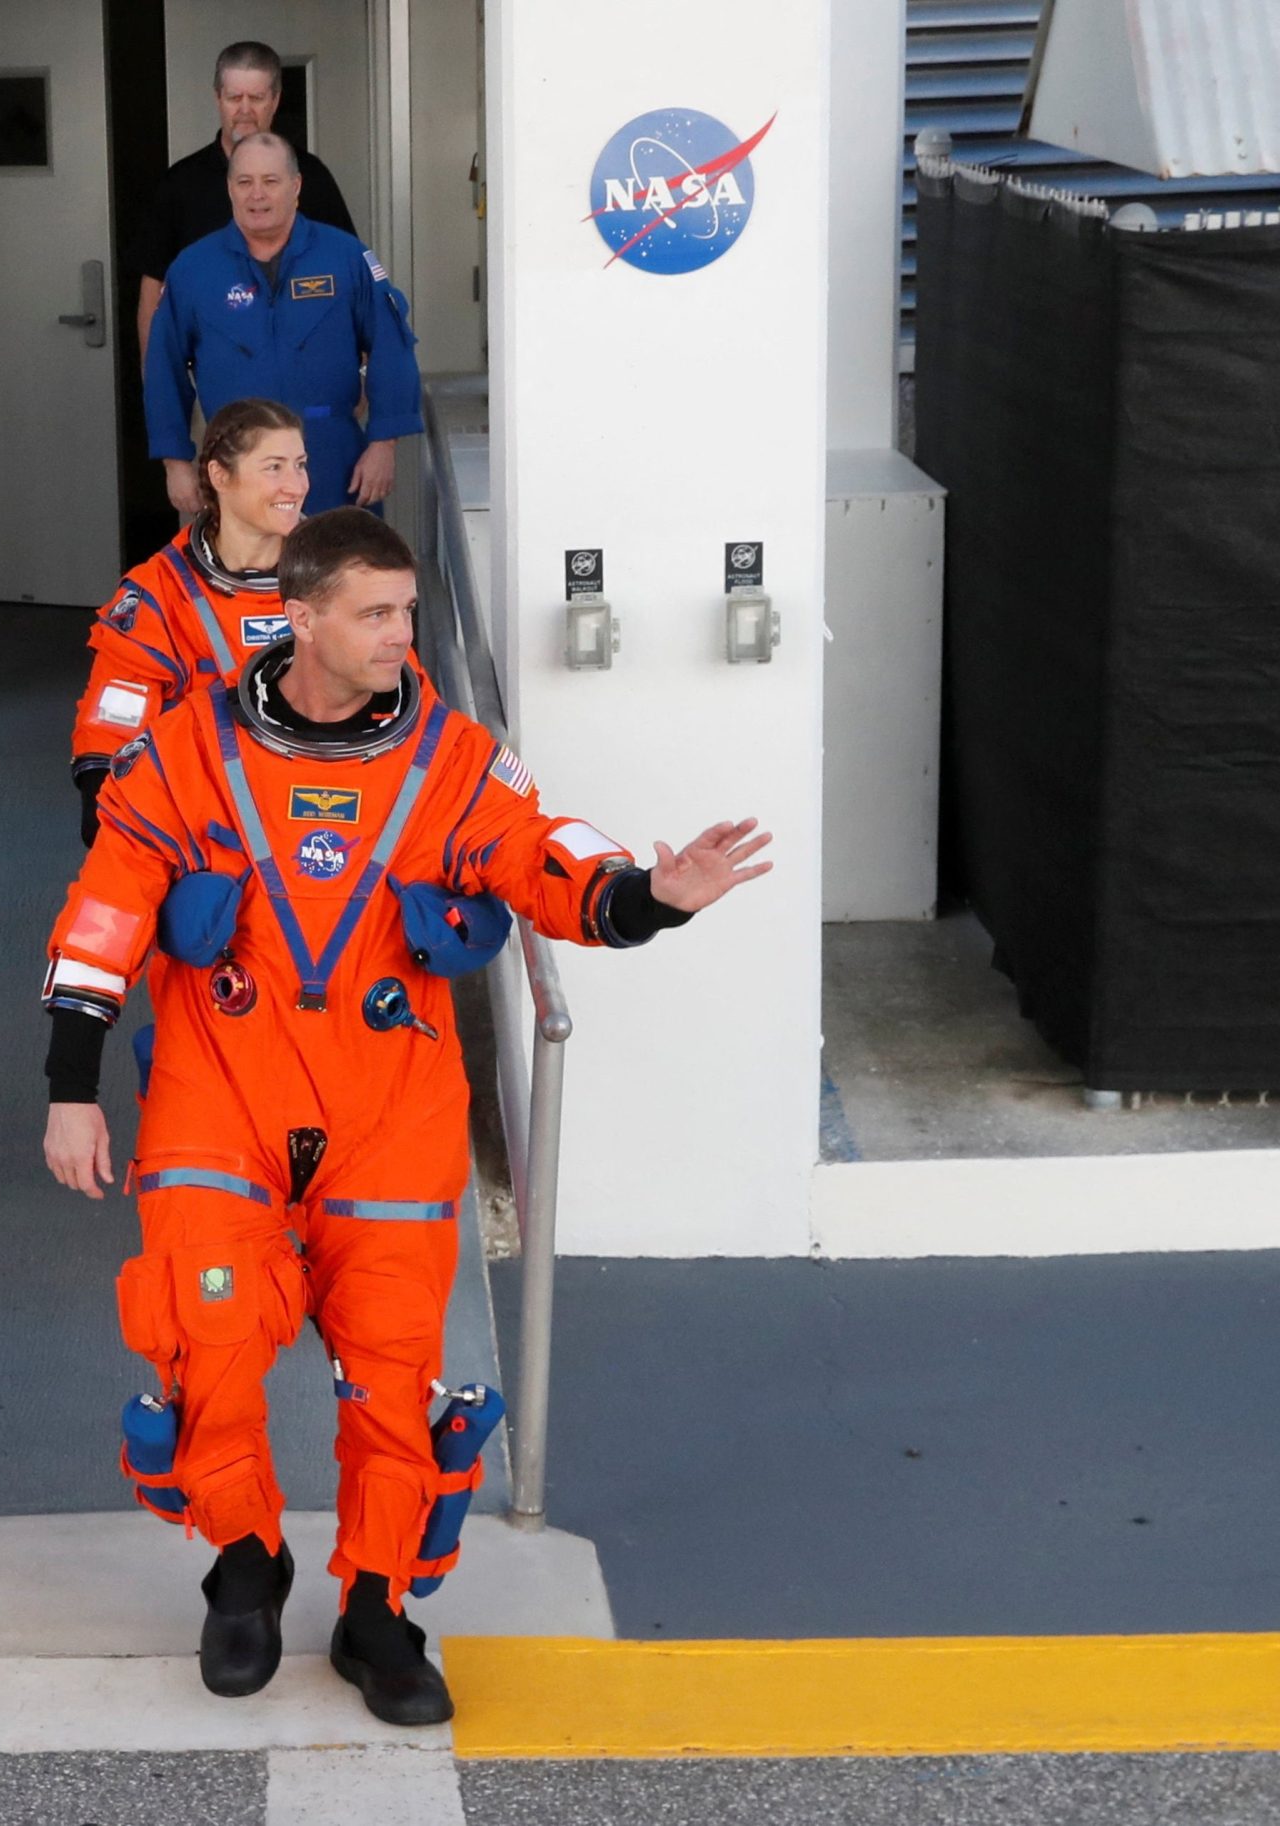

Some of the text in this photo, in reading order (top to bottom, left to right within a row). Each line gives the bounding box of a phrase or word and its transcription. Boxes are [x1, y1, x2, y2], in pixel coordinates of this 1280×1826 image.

[604, 172, 746, 212] NASA
[227, 291, 254, 303] NASA
[301, 846, 345, 864] NASA
